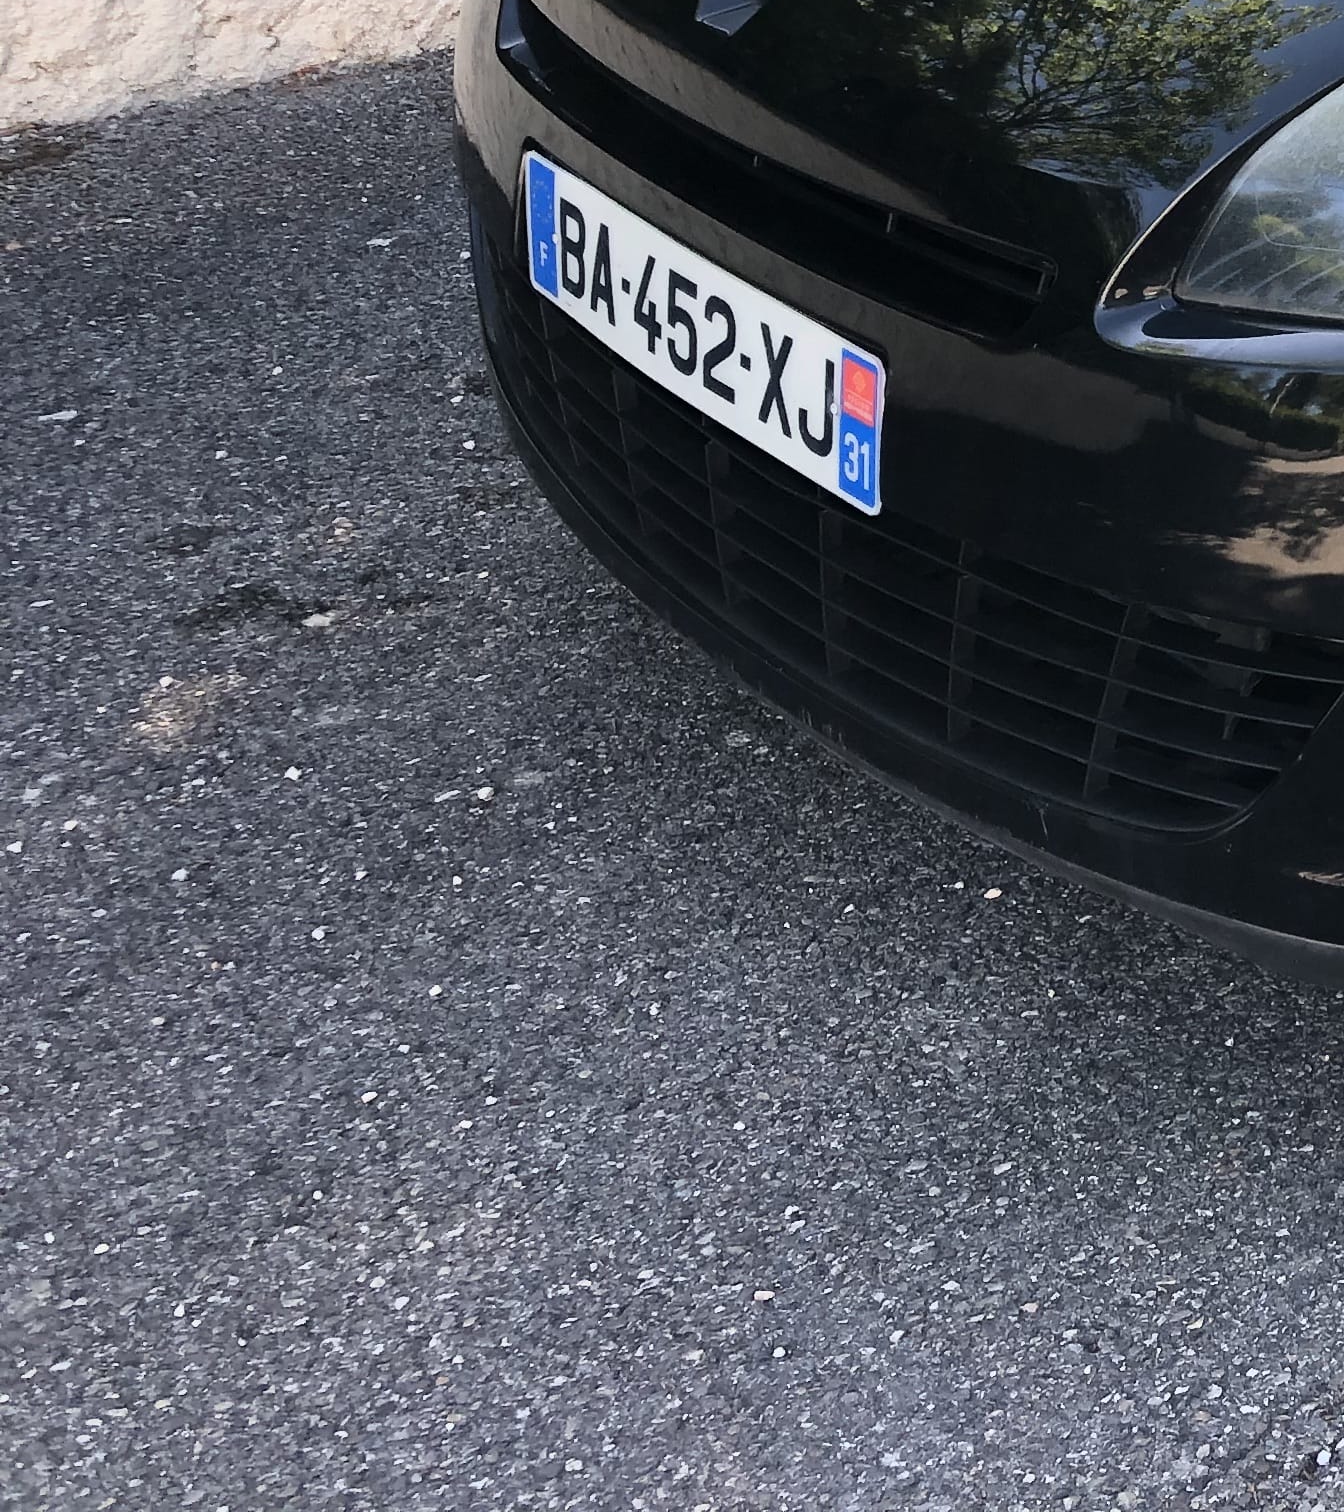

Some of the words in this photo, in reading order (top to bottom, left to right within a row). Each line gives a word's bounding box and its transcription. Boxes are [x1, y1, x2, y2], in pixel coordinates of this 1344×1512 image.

[539, 240, 549, 267] F
[559, 196, 835, 458] BA-452-XJ
[844, 432, 870, 491] 31
